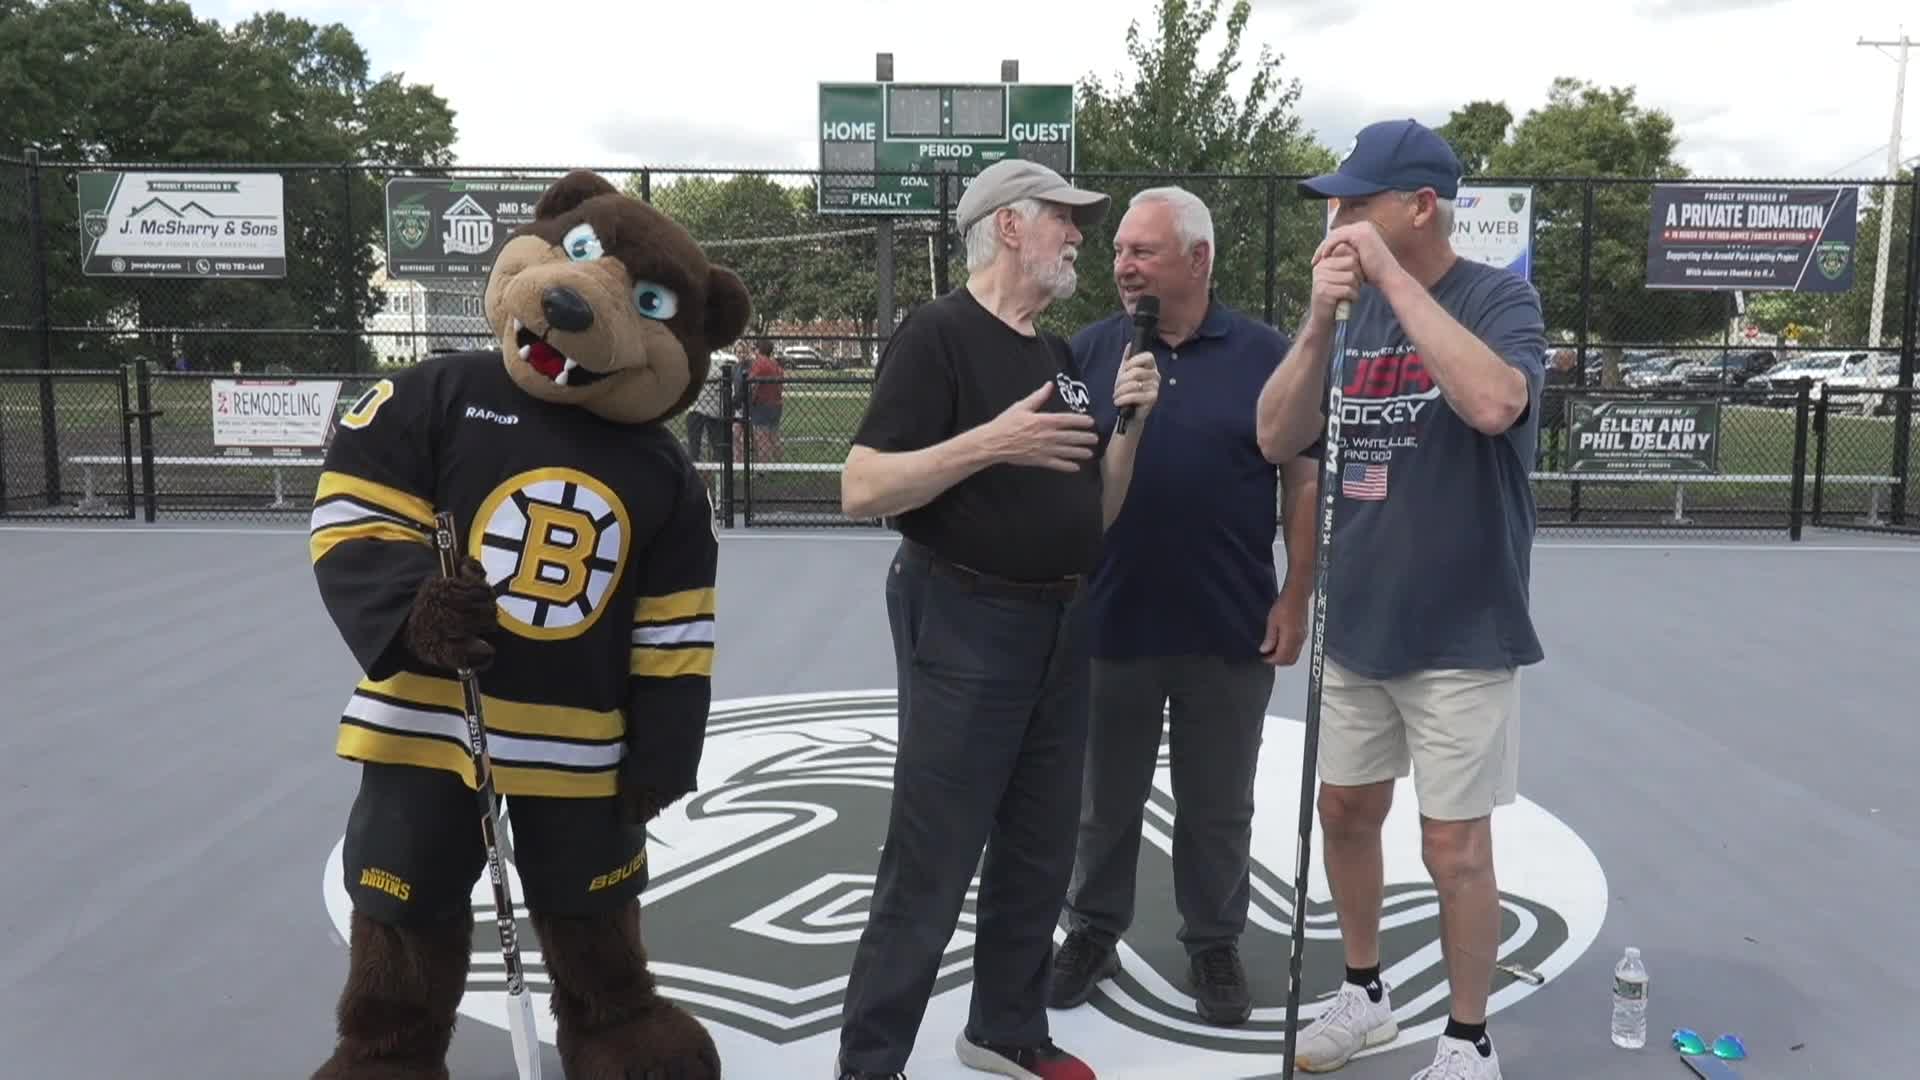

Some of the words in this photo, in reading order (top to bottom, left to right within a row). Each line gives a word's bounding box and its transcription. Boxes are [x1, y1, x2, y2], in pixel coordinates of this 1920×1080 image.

[823, 122, 876, 141] HOME
[1011, 122, 1071, 142] GUEST
[919, 144, 974, 157] PERIOD
[465, 183, 499, 192] PROUDLY
[900, 176, 929, 187] GOAL
[851, 192, 912, 207] PENALTY
[1704, 192, 1735, 201] PROUDLY
[1736, 193, 1777, 202] SPONSORED
[1779, 194, 1788, 202] BY
[496, 202, 519, 215] JMD
[1665, 203, 1678, 227] A
[1680, 203, 1744, 228] PRIVATE
[1746, 204, 1824, 229] DONATION
[120, 220, 133, 235] J.
[140, 220, 219, 238] McSharry
[224, 221, 236, 236] &
[240, 221, 279, 236] Sons
[1477, 220, 1519, 235] WEB
[1666, 250, 1700, 262] Supporting
[1701, 252, 1713, 260] the
[1735, 252, 1749, 260] Park
[1750, 252, 1776, 263] Lighting
[1776, 252, 1800, 263] Project
[1685, 268, 1701, 277] With
[1702, 269, 1728, 277] sincere
[1729, 268, 1752, 277] thanks
[233, 392, 321, 417] REMODELING
[1341, 401, 1427, 425] OCKEY
[1326, 386, 1342, 474] CCM
[1599, 418, 1654, 433] ELLEN
[1658, 418, 1696, 433] AND
[1579, 432, 1625, 450] PHIL
[1630, 432, 1712, 451] DELANY
[509, 502, 597, 604] B
[1312, 588, 1328, 677] JETSPEED
[489, 846, 502, 885] BOSTON
[360, 868, 411, 901] BRUINS
